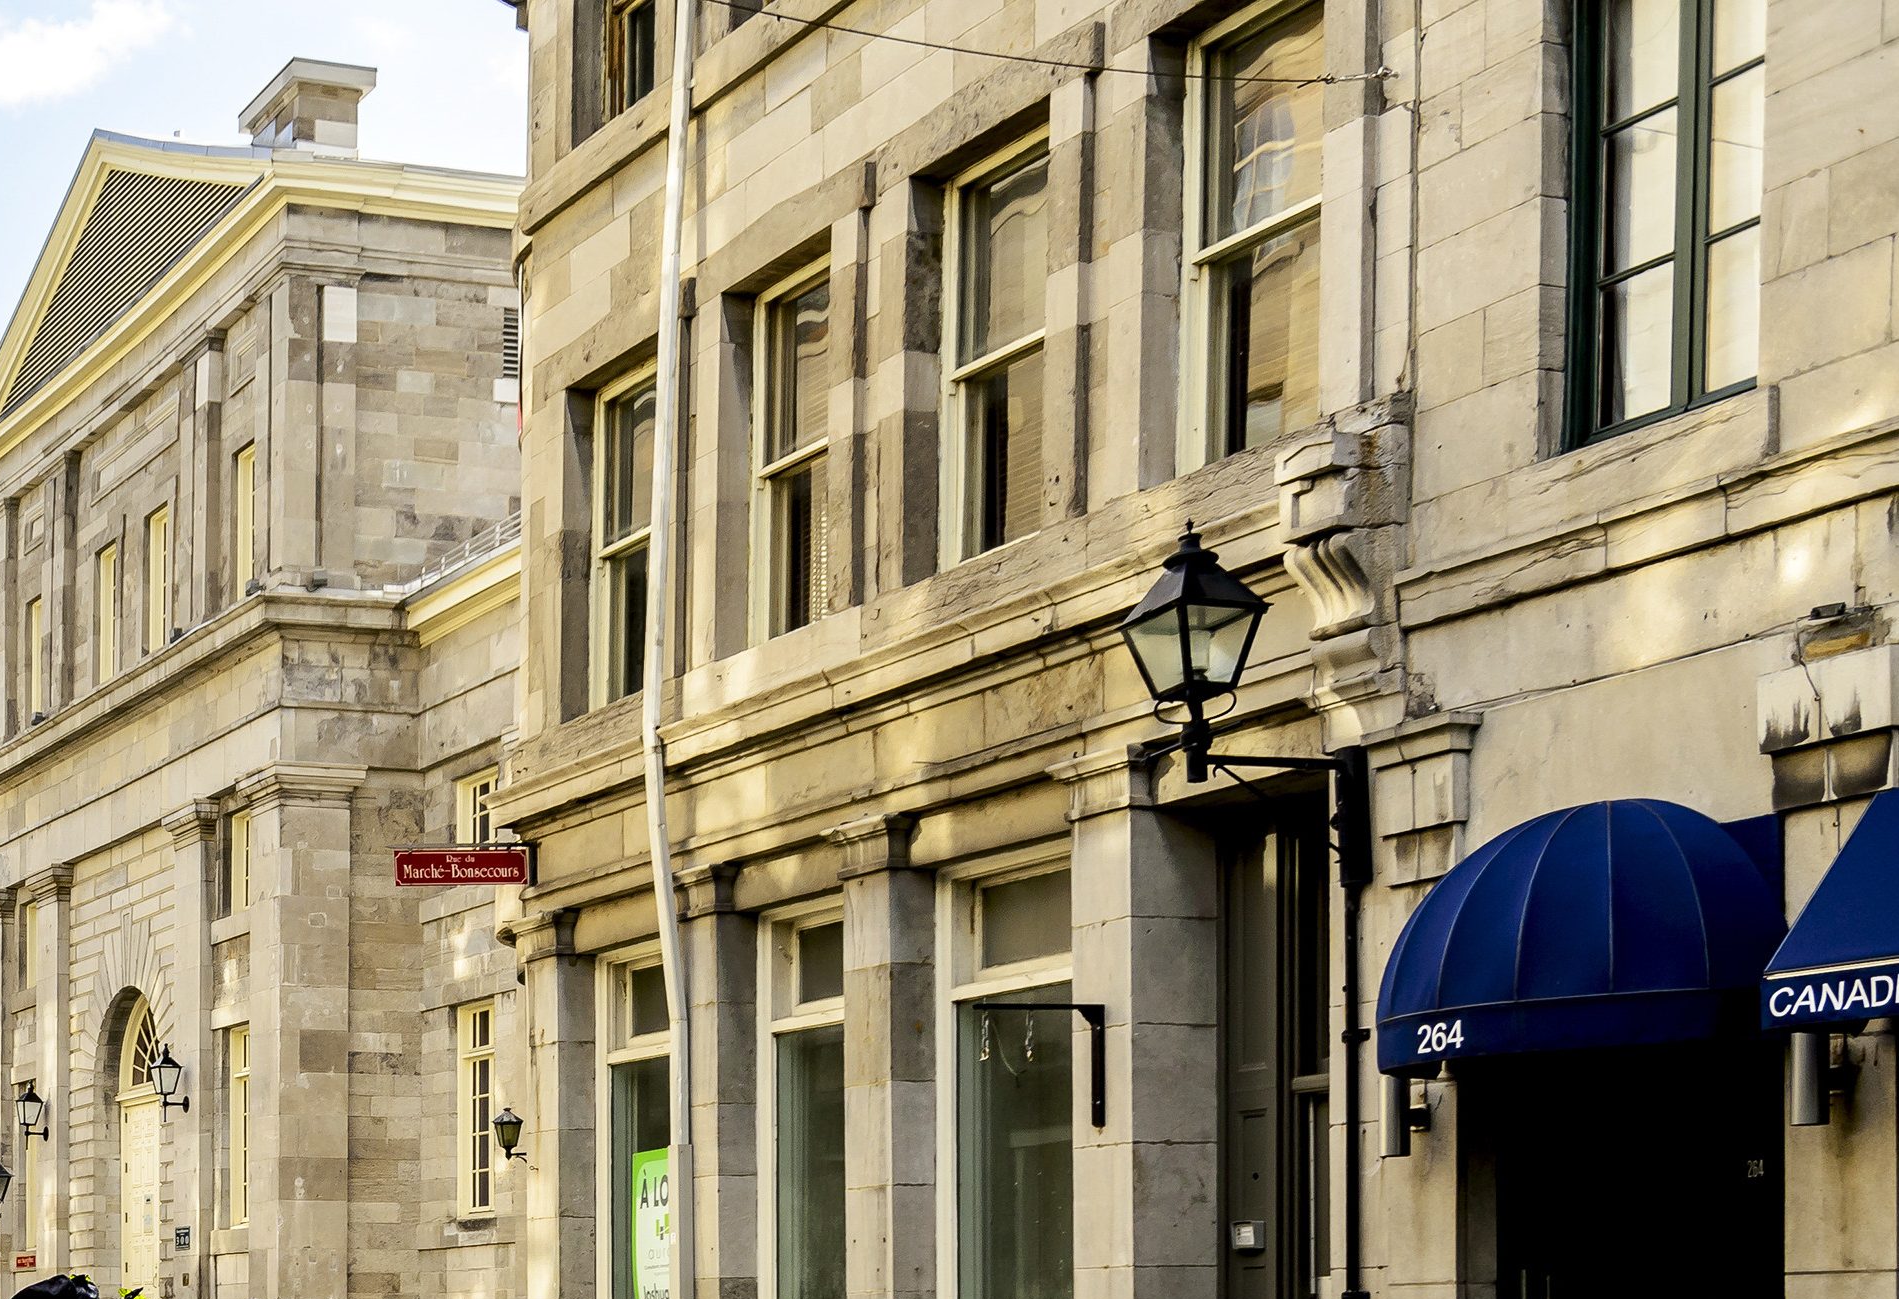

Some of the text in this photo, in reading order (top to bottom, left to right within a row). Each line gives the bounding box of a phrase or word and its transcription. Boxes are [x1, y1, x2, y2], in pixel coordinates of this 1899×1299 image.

[446, 854, 475, 863] Rue du
[403, 863, 520, 879] Marché-Bonsecours
[1417, 1019, 1465, 1055] 264
[1747, 1159, 1764, 1178] 264
[639, 1168, 649, 1209] À
